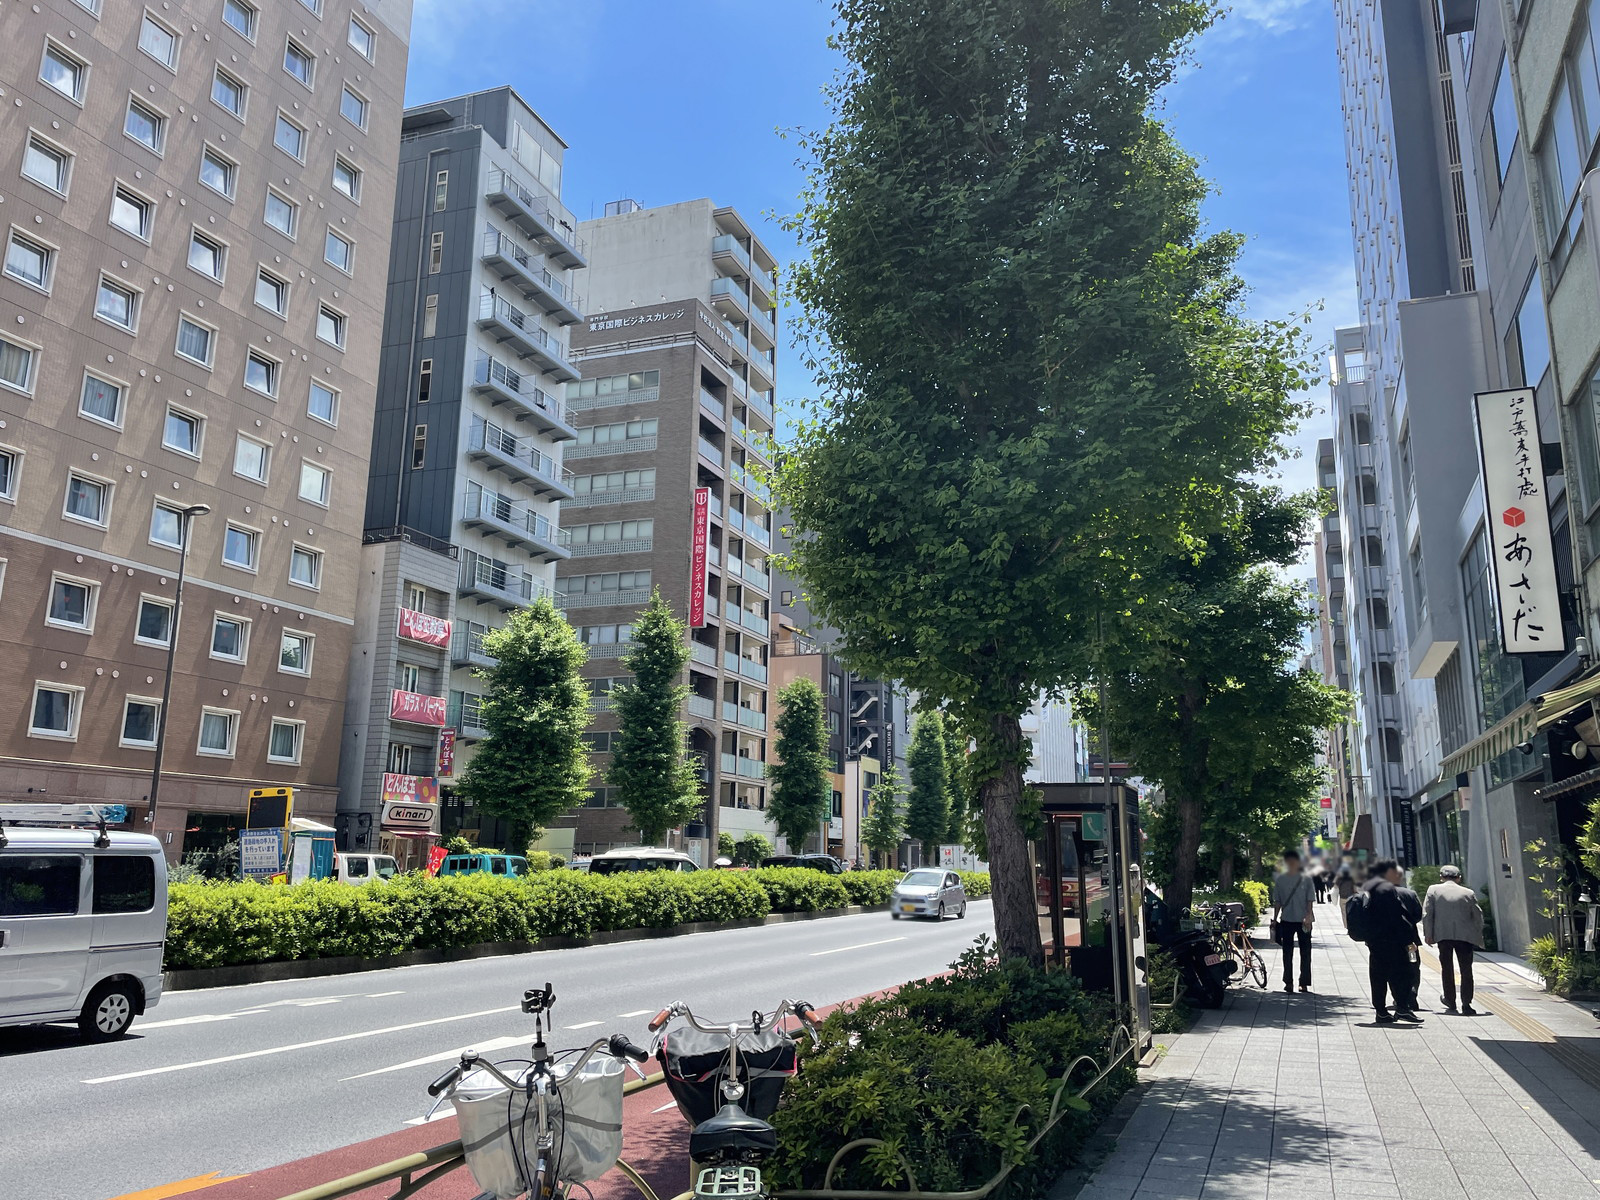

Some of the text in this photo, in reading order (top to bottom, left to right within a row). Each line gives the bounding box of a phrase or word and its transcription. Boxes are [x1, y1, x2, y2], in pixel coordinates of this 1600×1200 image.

[589, 308, 685, 332] 東京国際ビジネスカレッジ
[693, 516, 705, 623] 東京国際ビジネスカレッジ
[1503, 532, 1544, 642] あさだ
[386, 774, 417, 794] とんぼ玉
